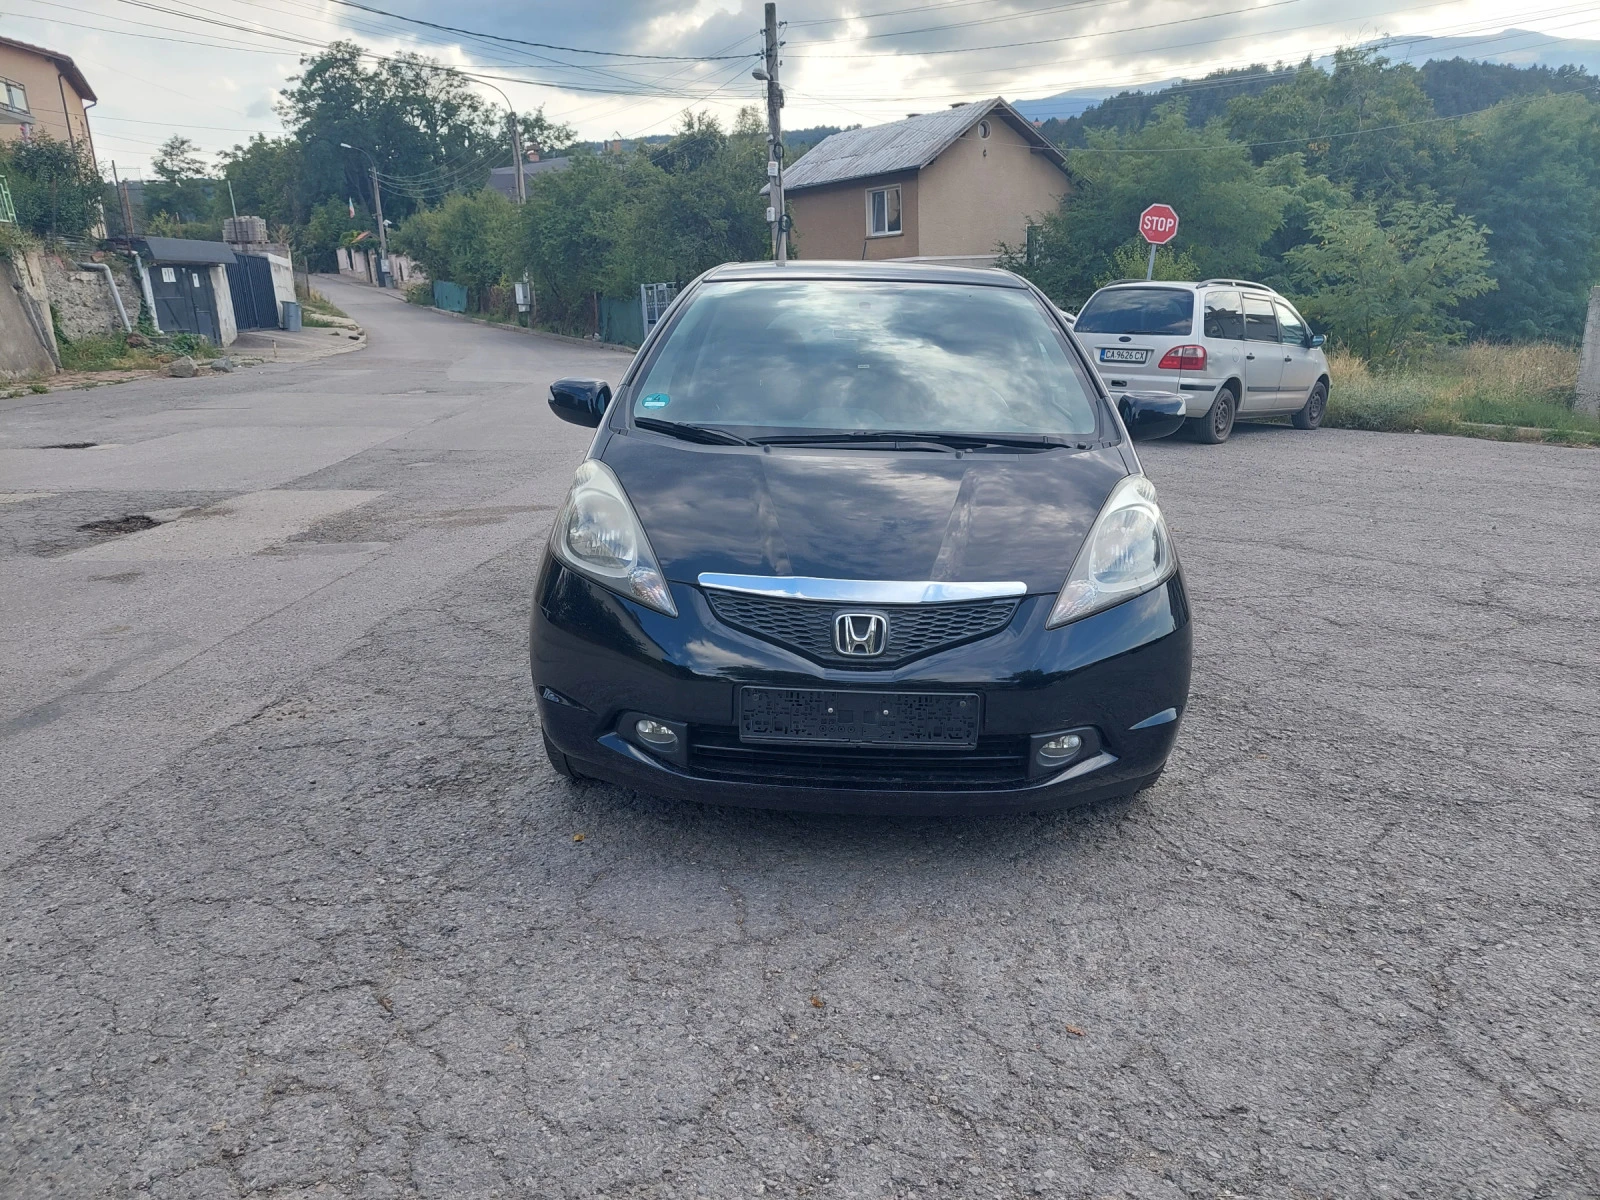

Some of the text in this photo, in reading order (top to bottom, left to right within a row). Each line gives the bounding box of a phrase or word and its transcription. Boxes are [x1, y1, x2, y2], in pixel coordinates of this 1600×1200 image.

[1143, 216, 1175, 232] STOP
[1105, 350, 1115, 359] CA
[1116, 350, 1134, 360] 9626
